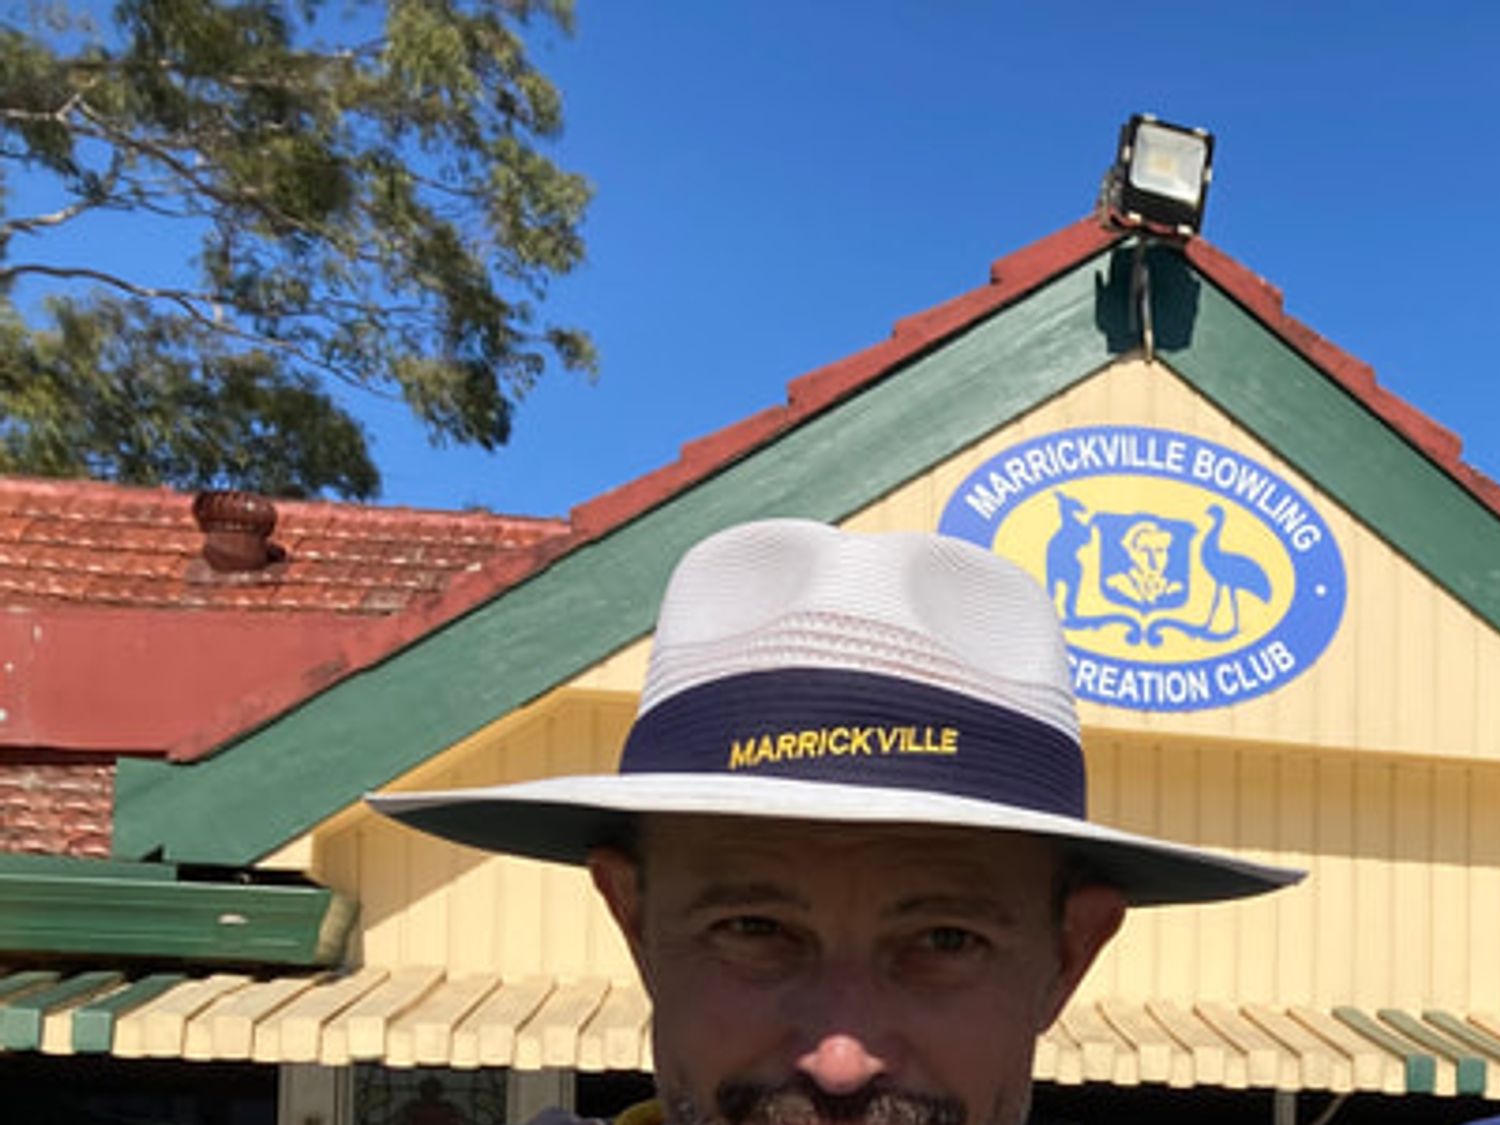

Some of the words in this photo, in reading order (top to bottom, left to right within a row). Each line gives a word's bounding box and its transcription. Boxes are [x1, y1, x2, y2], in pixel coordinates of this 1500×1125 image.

[966, 434, 1187, 520] MARRICKVILLE
[1192, 448, 1323, 553] BOWLING
[1067, 654, 1211, 705] REATION
[1215, 640, 1296, 696] CLUB
[728, 726, 959, 771] MARRICKVILLE
